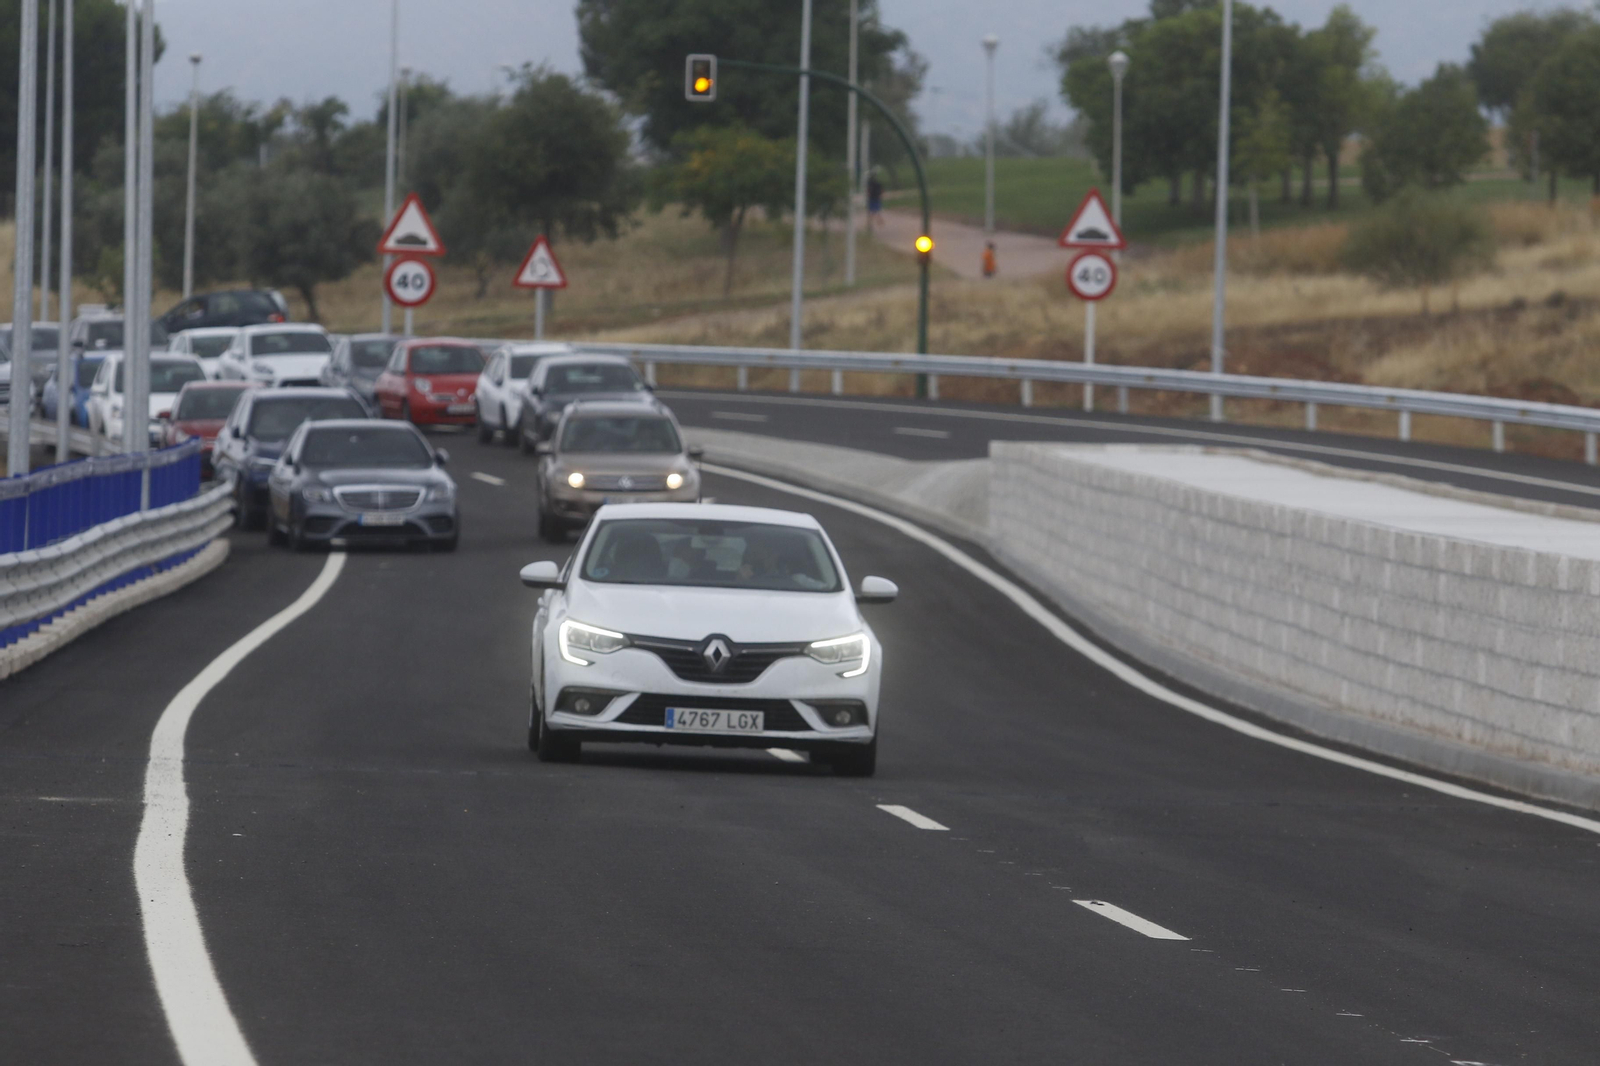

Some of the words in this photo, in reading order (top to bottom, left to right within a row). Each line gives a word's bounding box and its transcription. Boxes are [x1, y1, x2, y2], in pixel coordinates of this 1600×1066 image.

[396, 271, 425, 291] 40
[1077, 266, 1107, 286] 40
[677, 711, 720, 728] 4767
[726, 713, 759, 730] LGX
